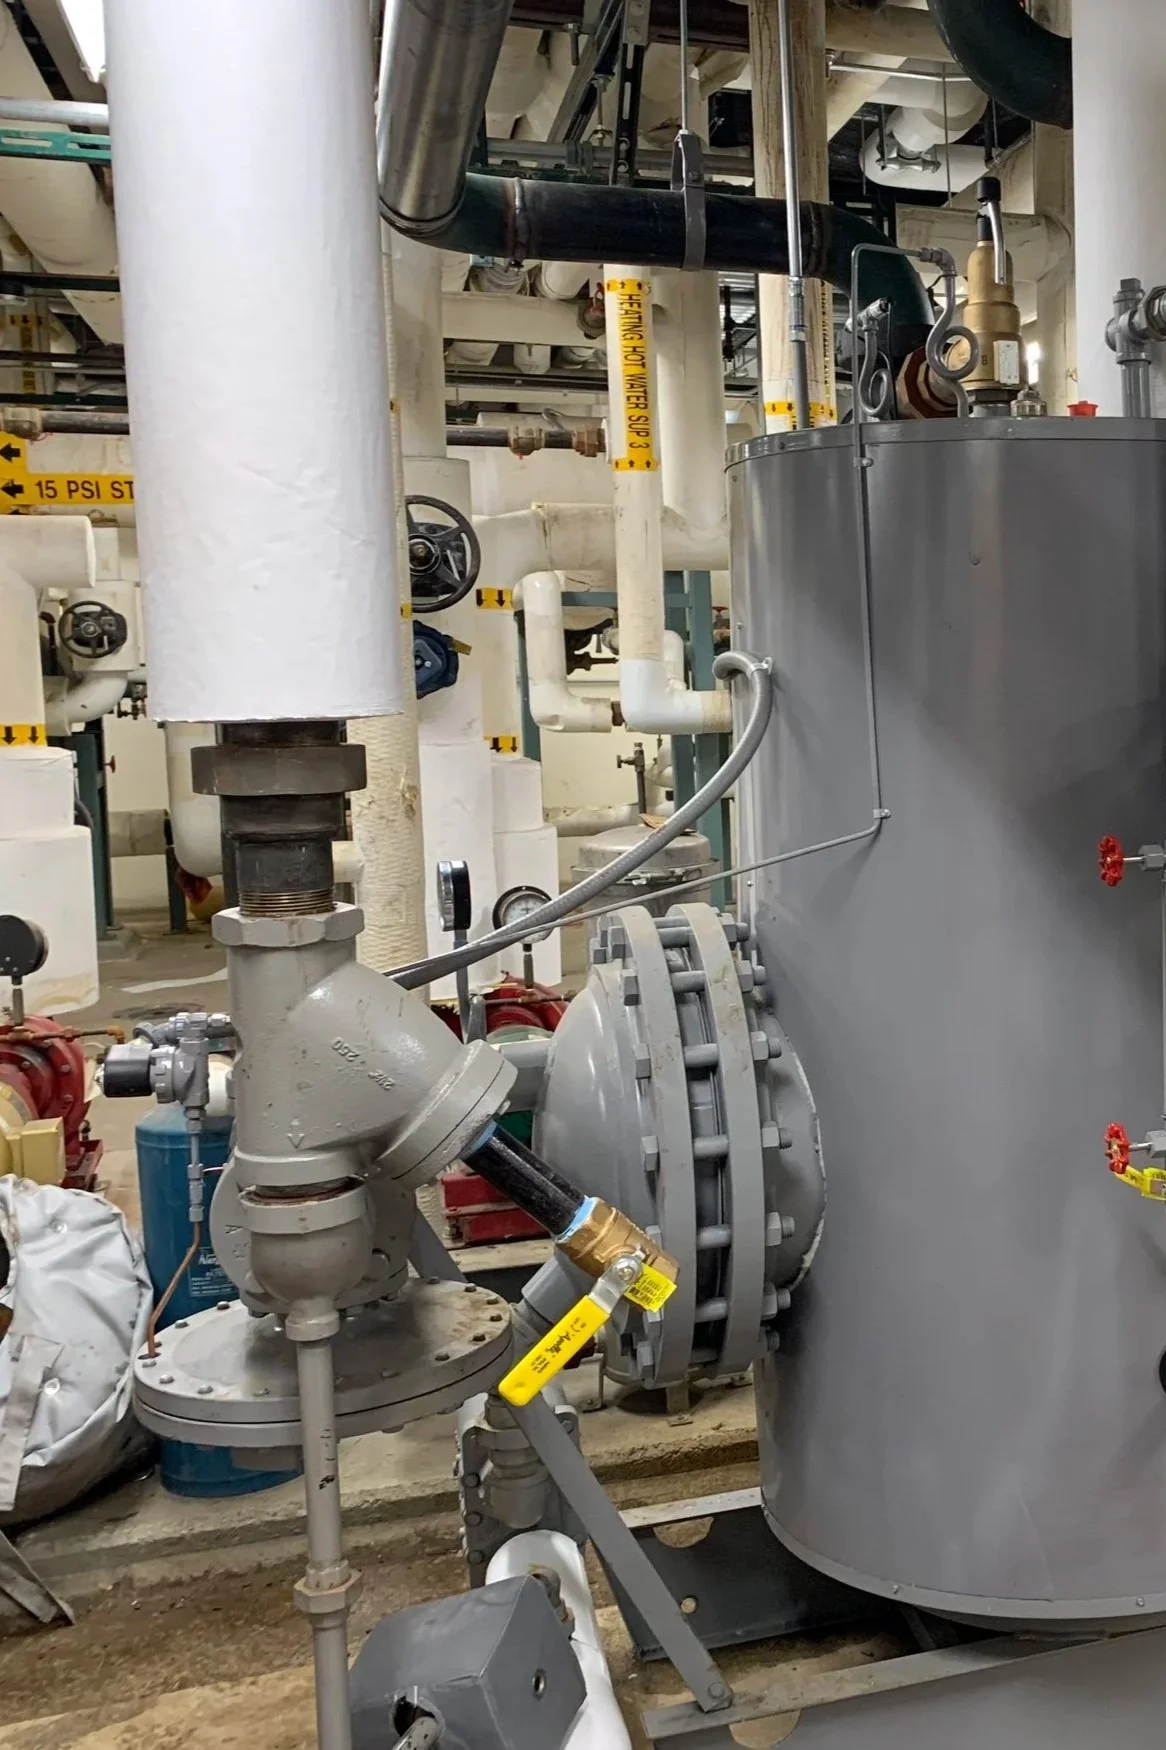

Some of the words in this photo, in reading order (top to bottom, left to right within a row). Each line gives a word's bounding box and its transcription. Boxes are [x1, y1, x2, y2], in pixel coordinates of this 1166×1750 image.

[618, 294, 644, 341] HEATING
[623, 346, 646, 369] HOT
[624, 373, 648, 410] WATER
[628, 415, 649, 438] SUP
[629, 442, 650, 450] 3
[35, 480, 58, 499] 15
[67, 480, 101, 499] PSI
